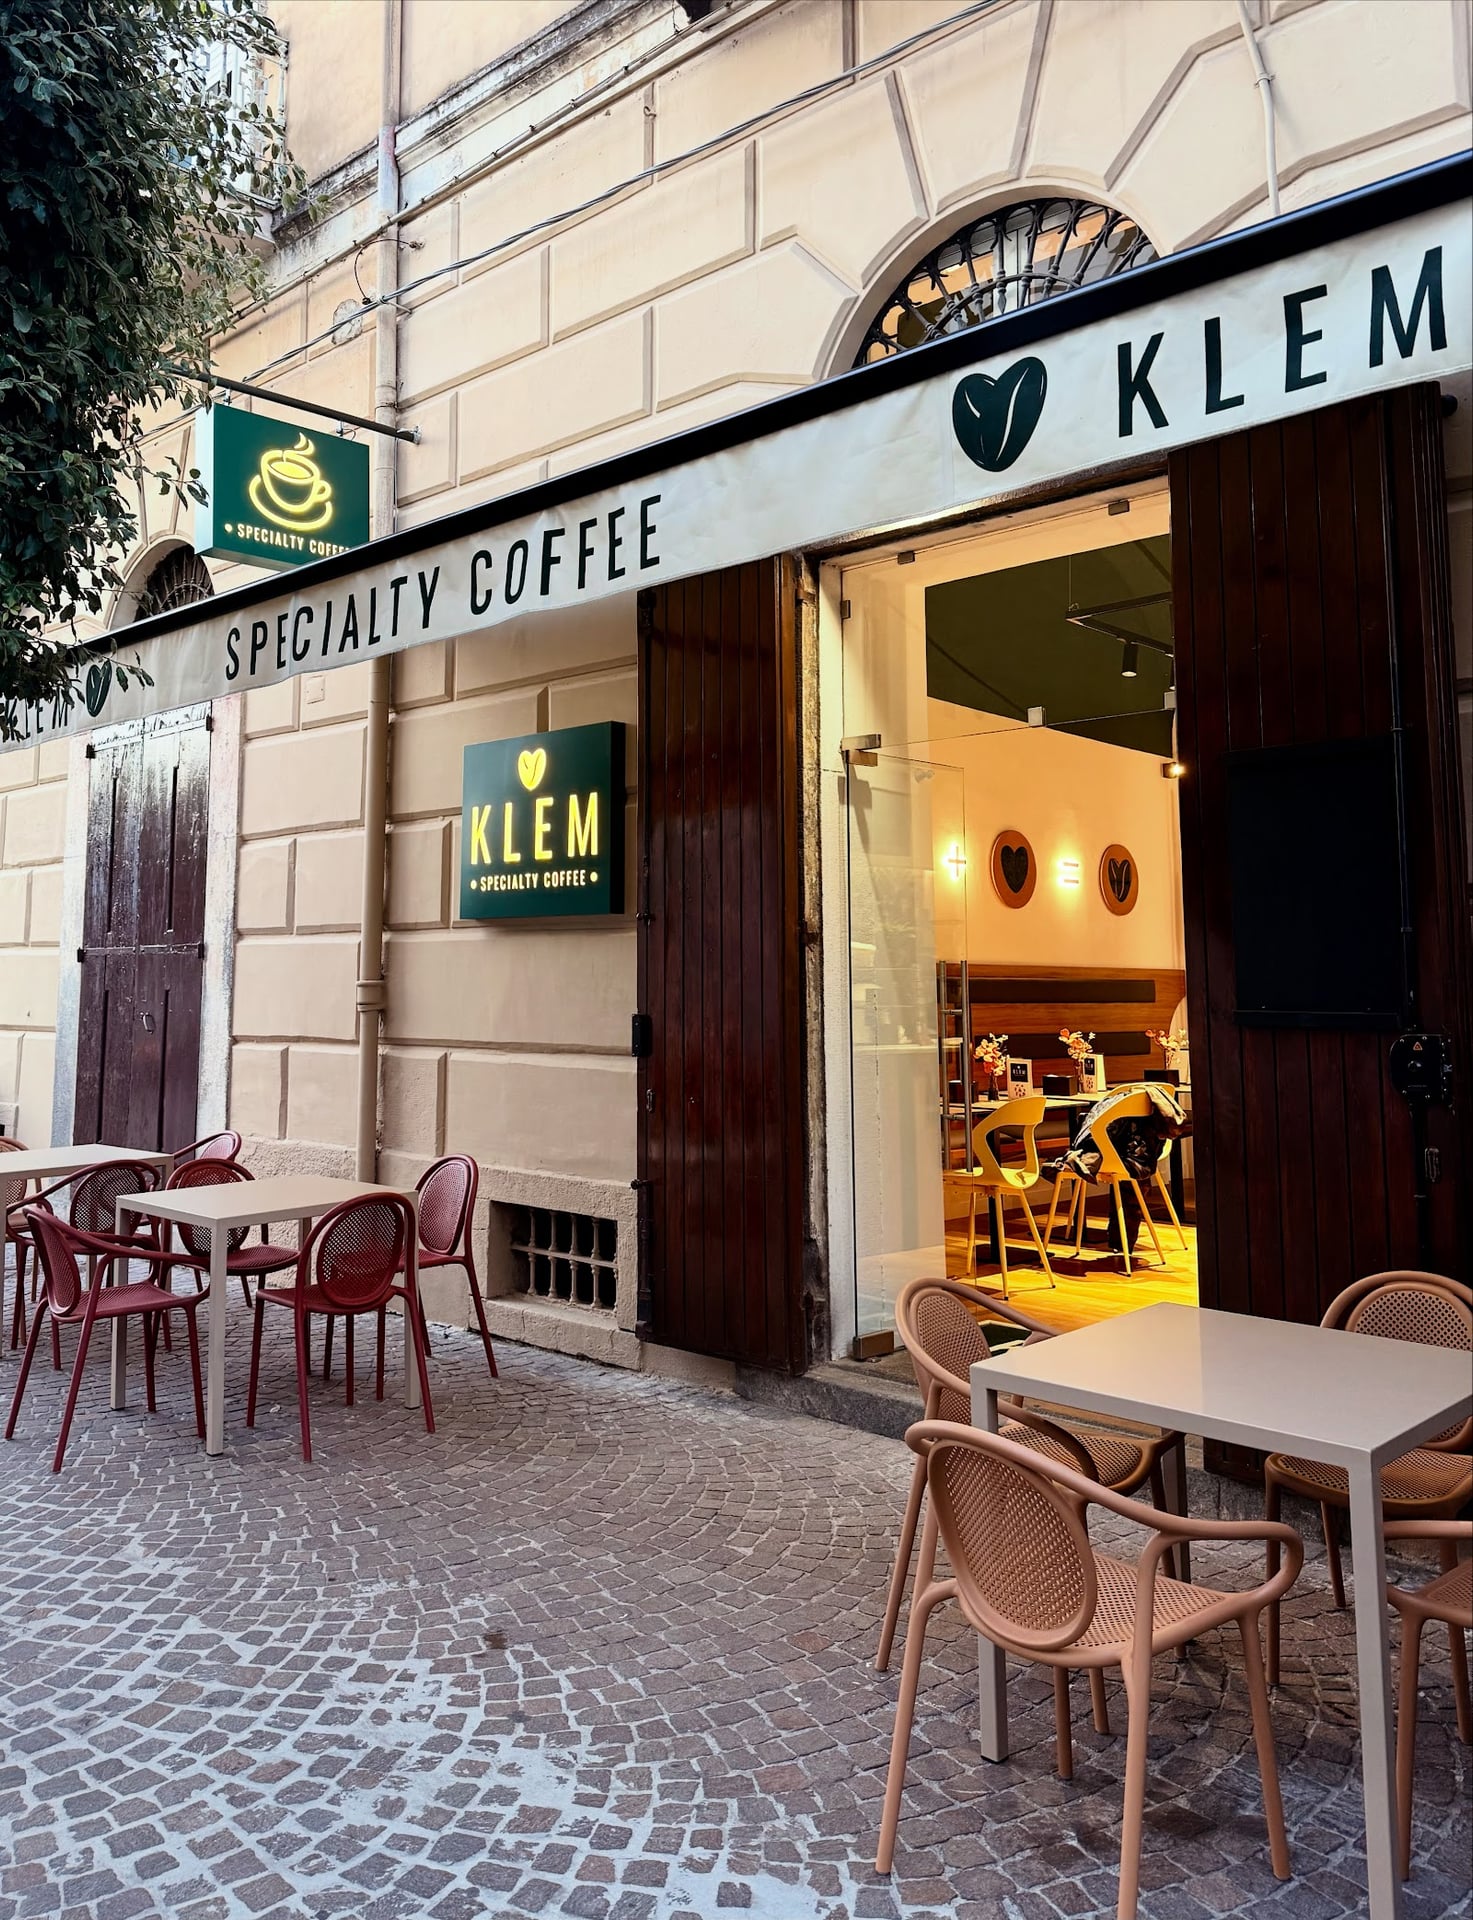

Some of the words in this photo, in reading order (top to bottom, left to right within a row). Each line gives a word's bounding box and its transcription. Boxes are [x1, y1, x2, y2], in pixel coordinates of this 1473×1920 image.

[1117, 245, 1448, 438] KLEM
[237, 523, 304, 550] SPECIALTY
[309, 539, 350, 557] COFF
[226, 566, 440, 680] SPECIALTY
[470, 495, 661, 615] COFFEE
[470, 791, 599, 865] KLEM
[480, 872, 539, 892] SPECIALTY
[543, 869, 586, 888] COFFEE
